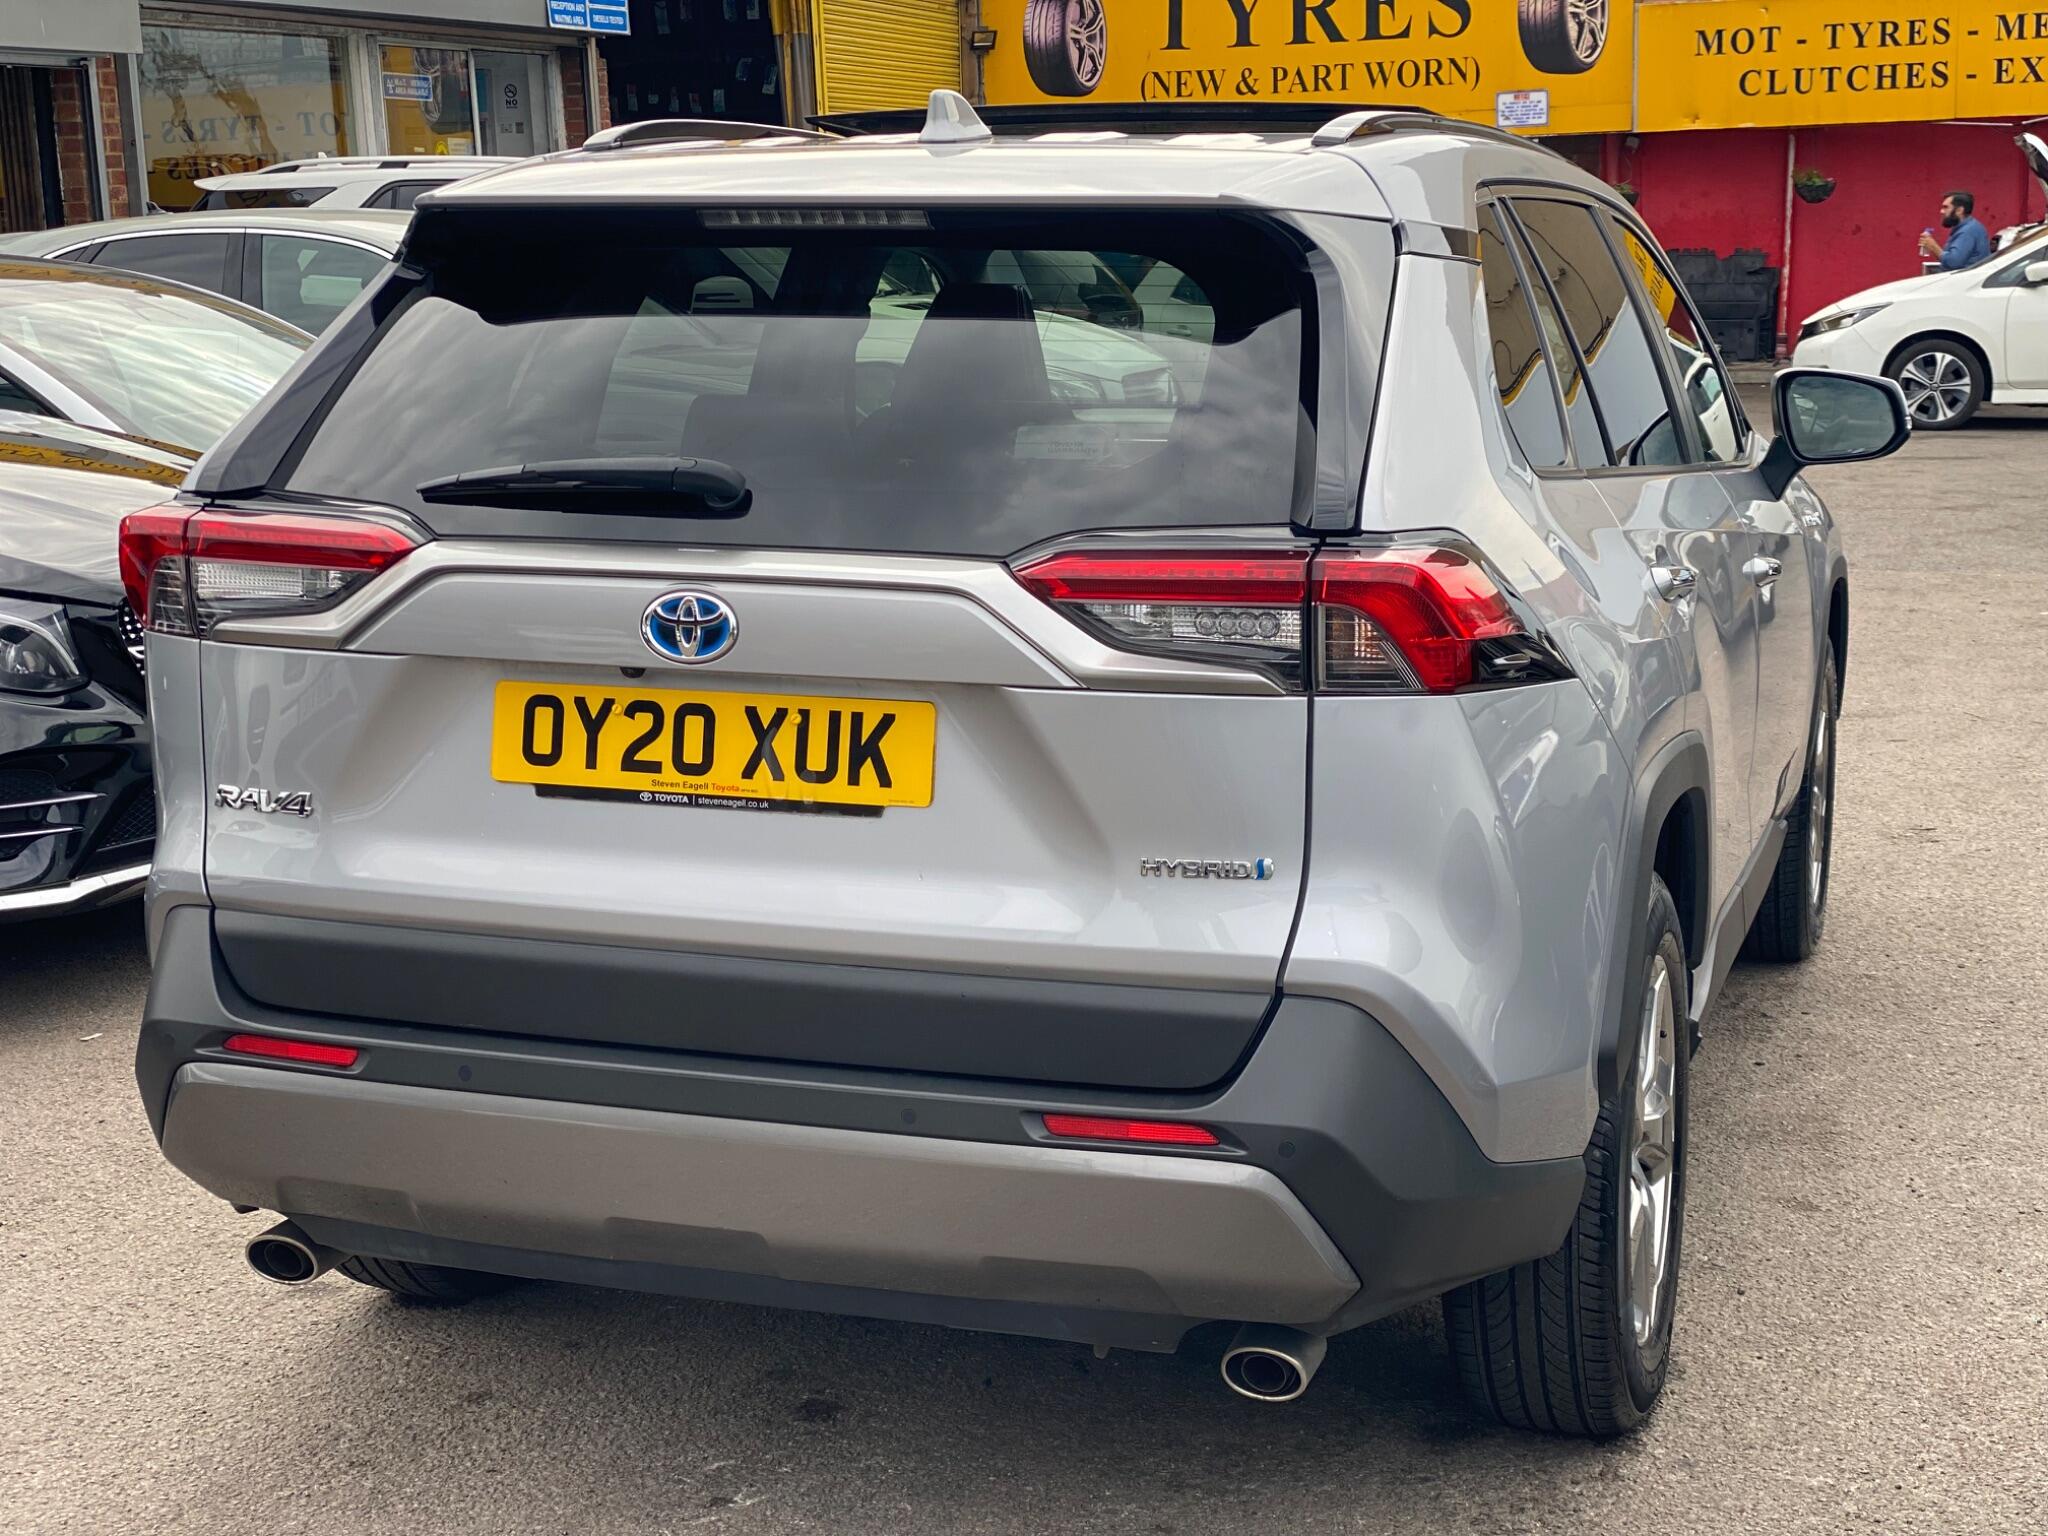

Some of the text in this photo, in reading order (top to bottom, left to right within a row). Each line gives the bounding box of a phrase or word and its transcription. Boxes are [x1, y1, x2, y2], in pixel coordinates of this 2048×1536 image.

[1160, 0, 1472, 50] TYRES
[1695, 26, 1781, 56] MOT
[1824, 17, 1951, 50] TYRES
[1140, 56, 1481, 101] (NEW & PART WORN)
[1739, 61, 1949, 96] CLUTCHES
[522, 694, 896, 788] OY20 XUK
[215, 784, 313, 818] RAV4
[651, 779, 680, 788] Steven
[682, 781, 709, 791] Eagell
[710, 783, 740, 793] Toyota
[654, 793, 689, 804] TOYOTA
[1140, 857, 1252, 880] HYBRID
